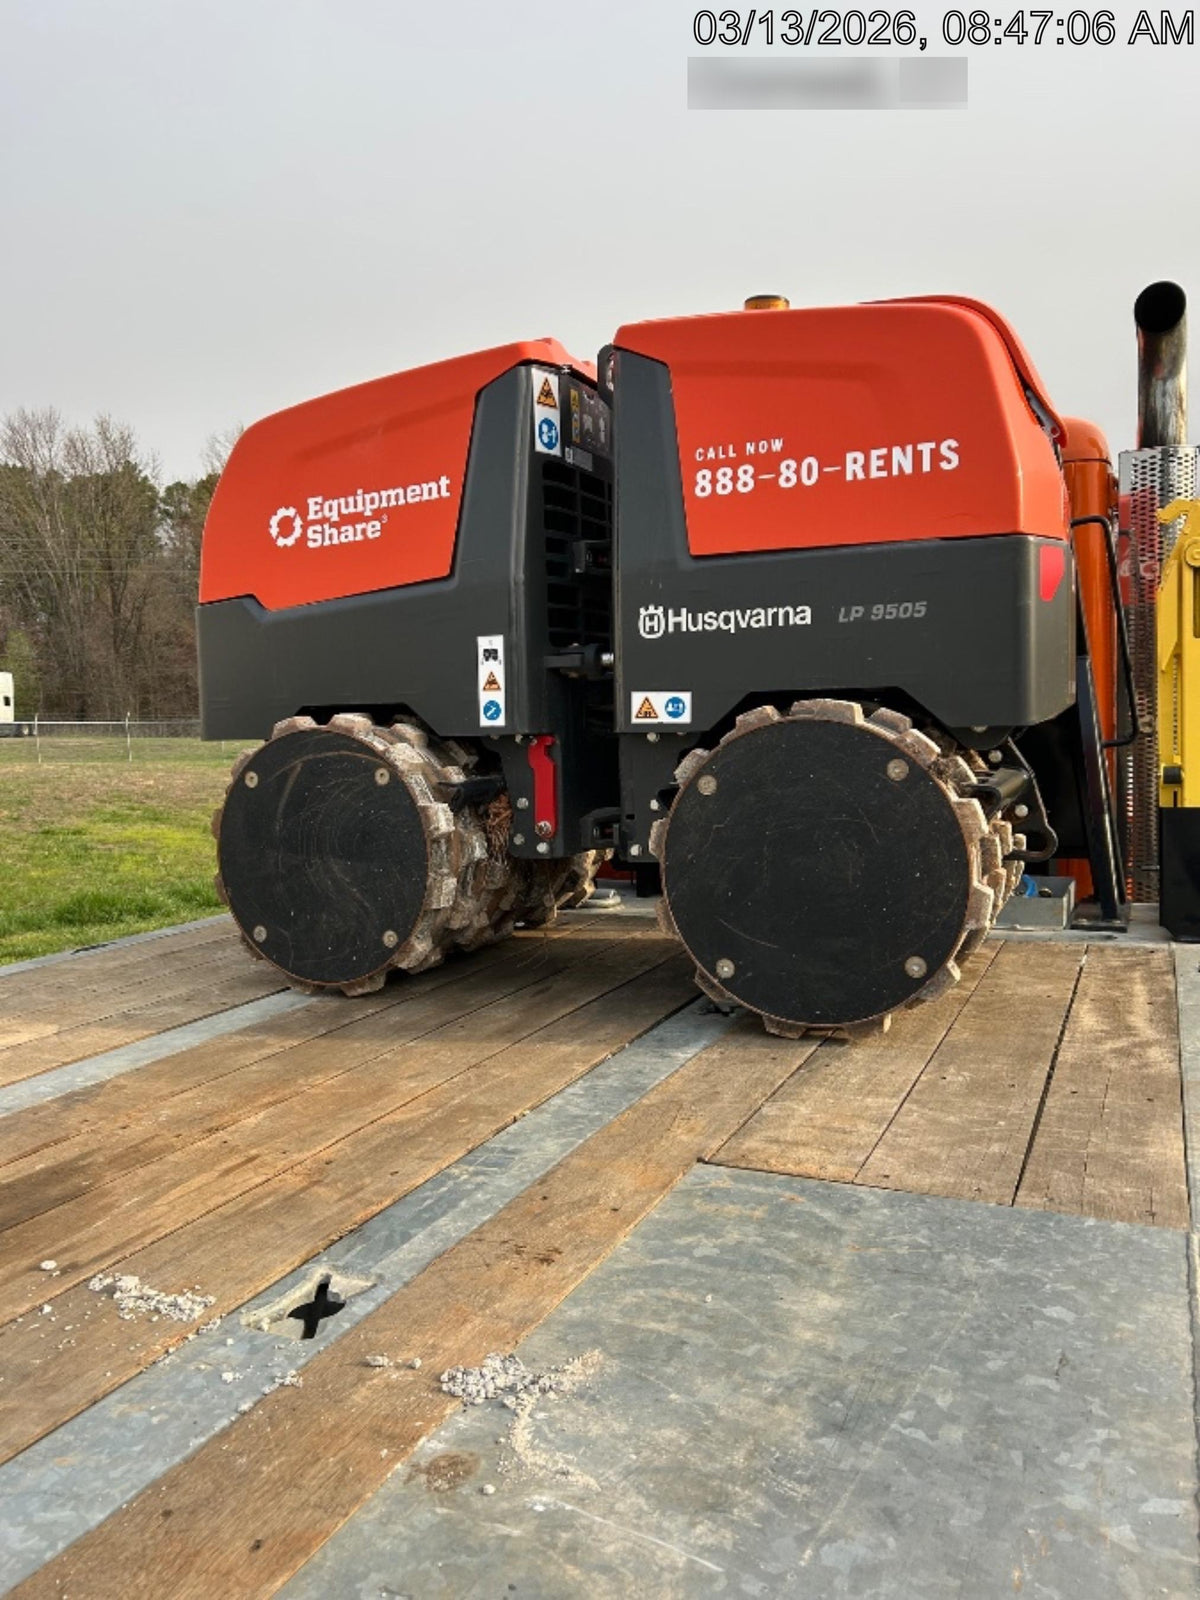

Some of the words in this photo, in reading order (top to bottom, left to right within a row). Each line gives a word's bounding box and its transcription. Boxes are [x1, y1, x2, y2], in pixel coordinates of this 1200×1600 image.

[694, 443, 737, 462] CALL
[746, 437, 785, 456] NOW
[694, 438, 960, 498] 888-80-RENTS
[306, 475, 451, 522] Equipment
[667, 604, 813, 634] Husqvarna
[838, 606, 864, 623] LP
[870, 601, 928, 621] 9505
